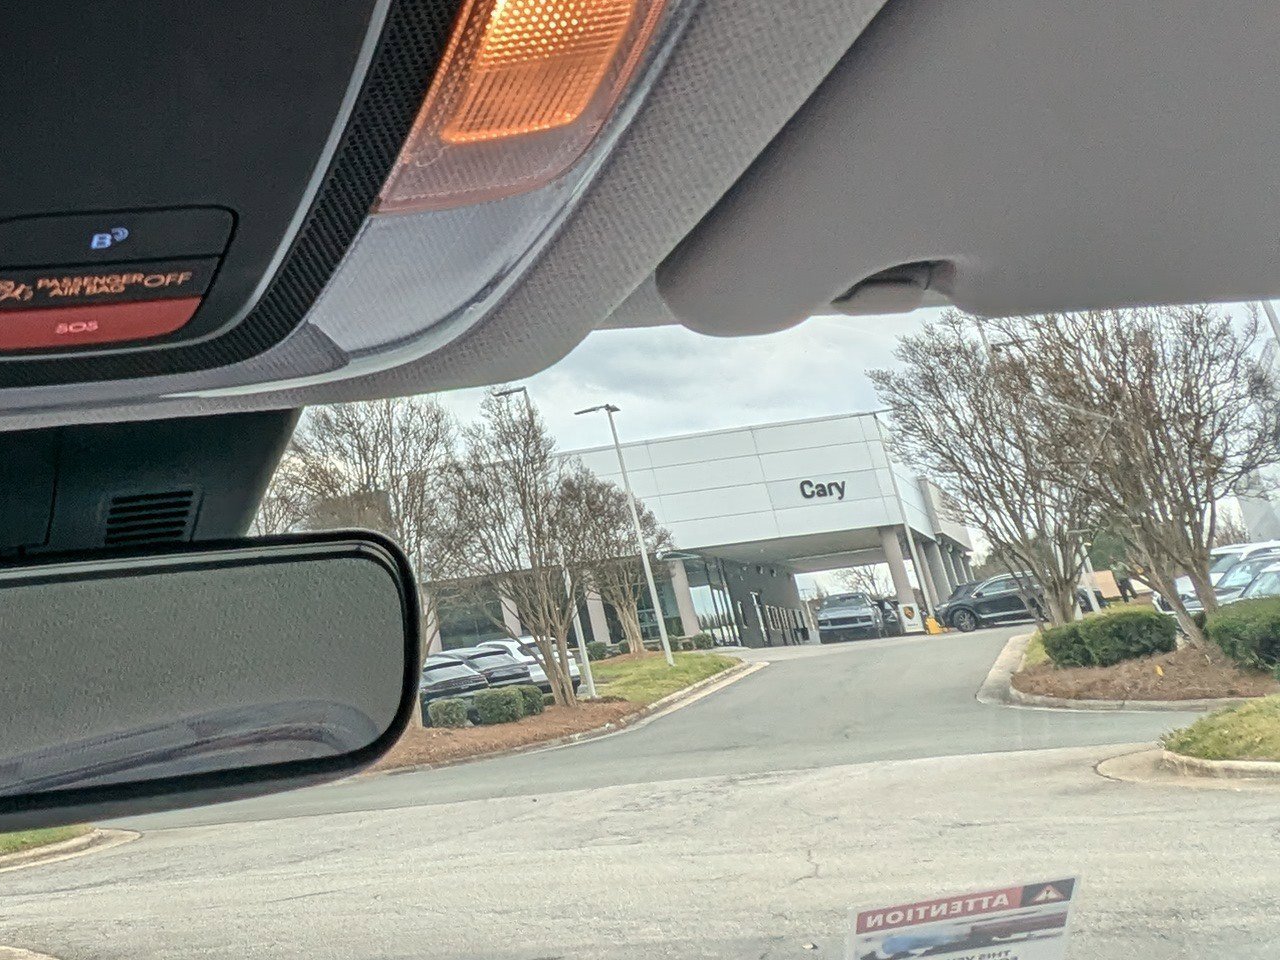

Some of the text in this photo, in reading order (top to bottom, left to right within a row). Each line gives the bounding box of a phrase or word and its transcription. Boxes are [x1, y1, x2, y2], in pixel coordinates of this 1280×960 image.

[37, 271, 145, 290] PASSENGER
[143, 271, 193, 288] OFF
[49, 283, 126, 298] AIR BAG
[55, 320, 99, 335] SOS
[799, 479, 846, 500] Cary
